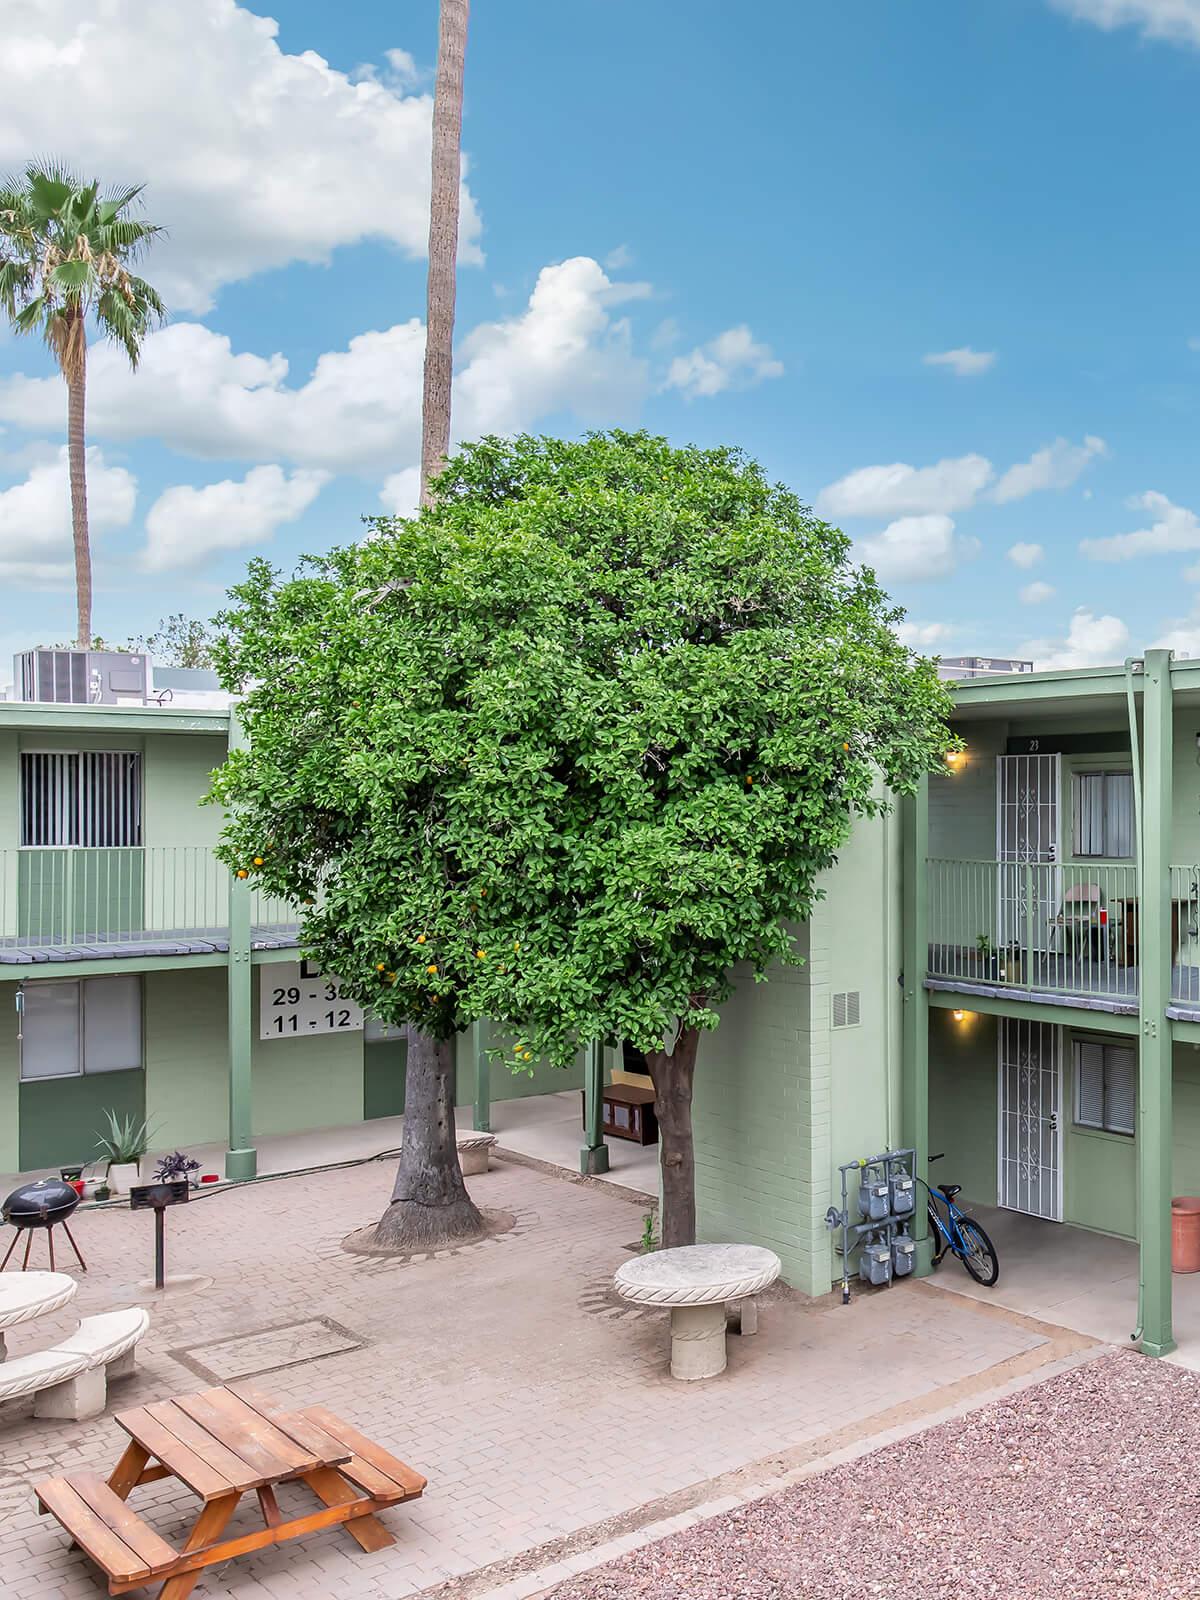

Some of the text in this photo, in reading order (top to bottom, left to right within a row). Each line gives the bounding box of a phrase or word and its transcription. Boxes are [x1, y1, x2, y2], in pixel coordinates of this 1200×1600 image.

[1029, 740, 1039, 751] 23
[272, 987, 300, 1006] 29
[273, 1014, 298, 1033] 11
[325, 1009, 350, 1028] 12
